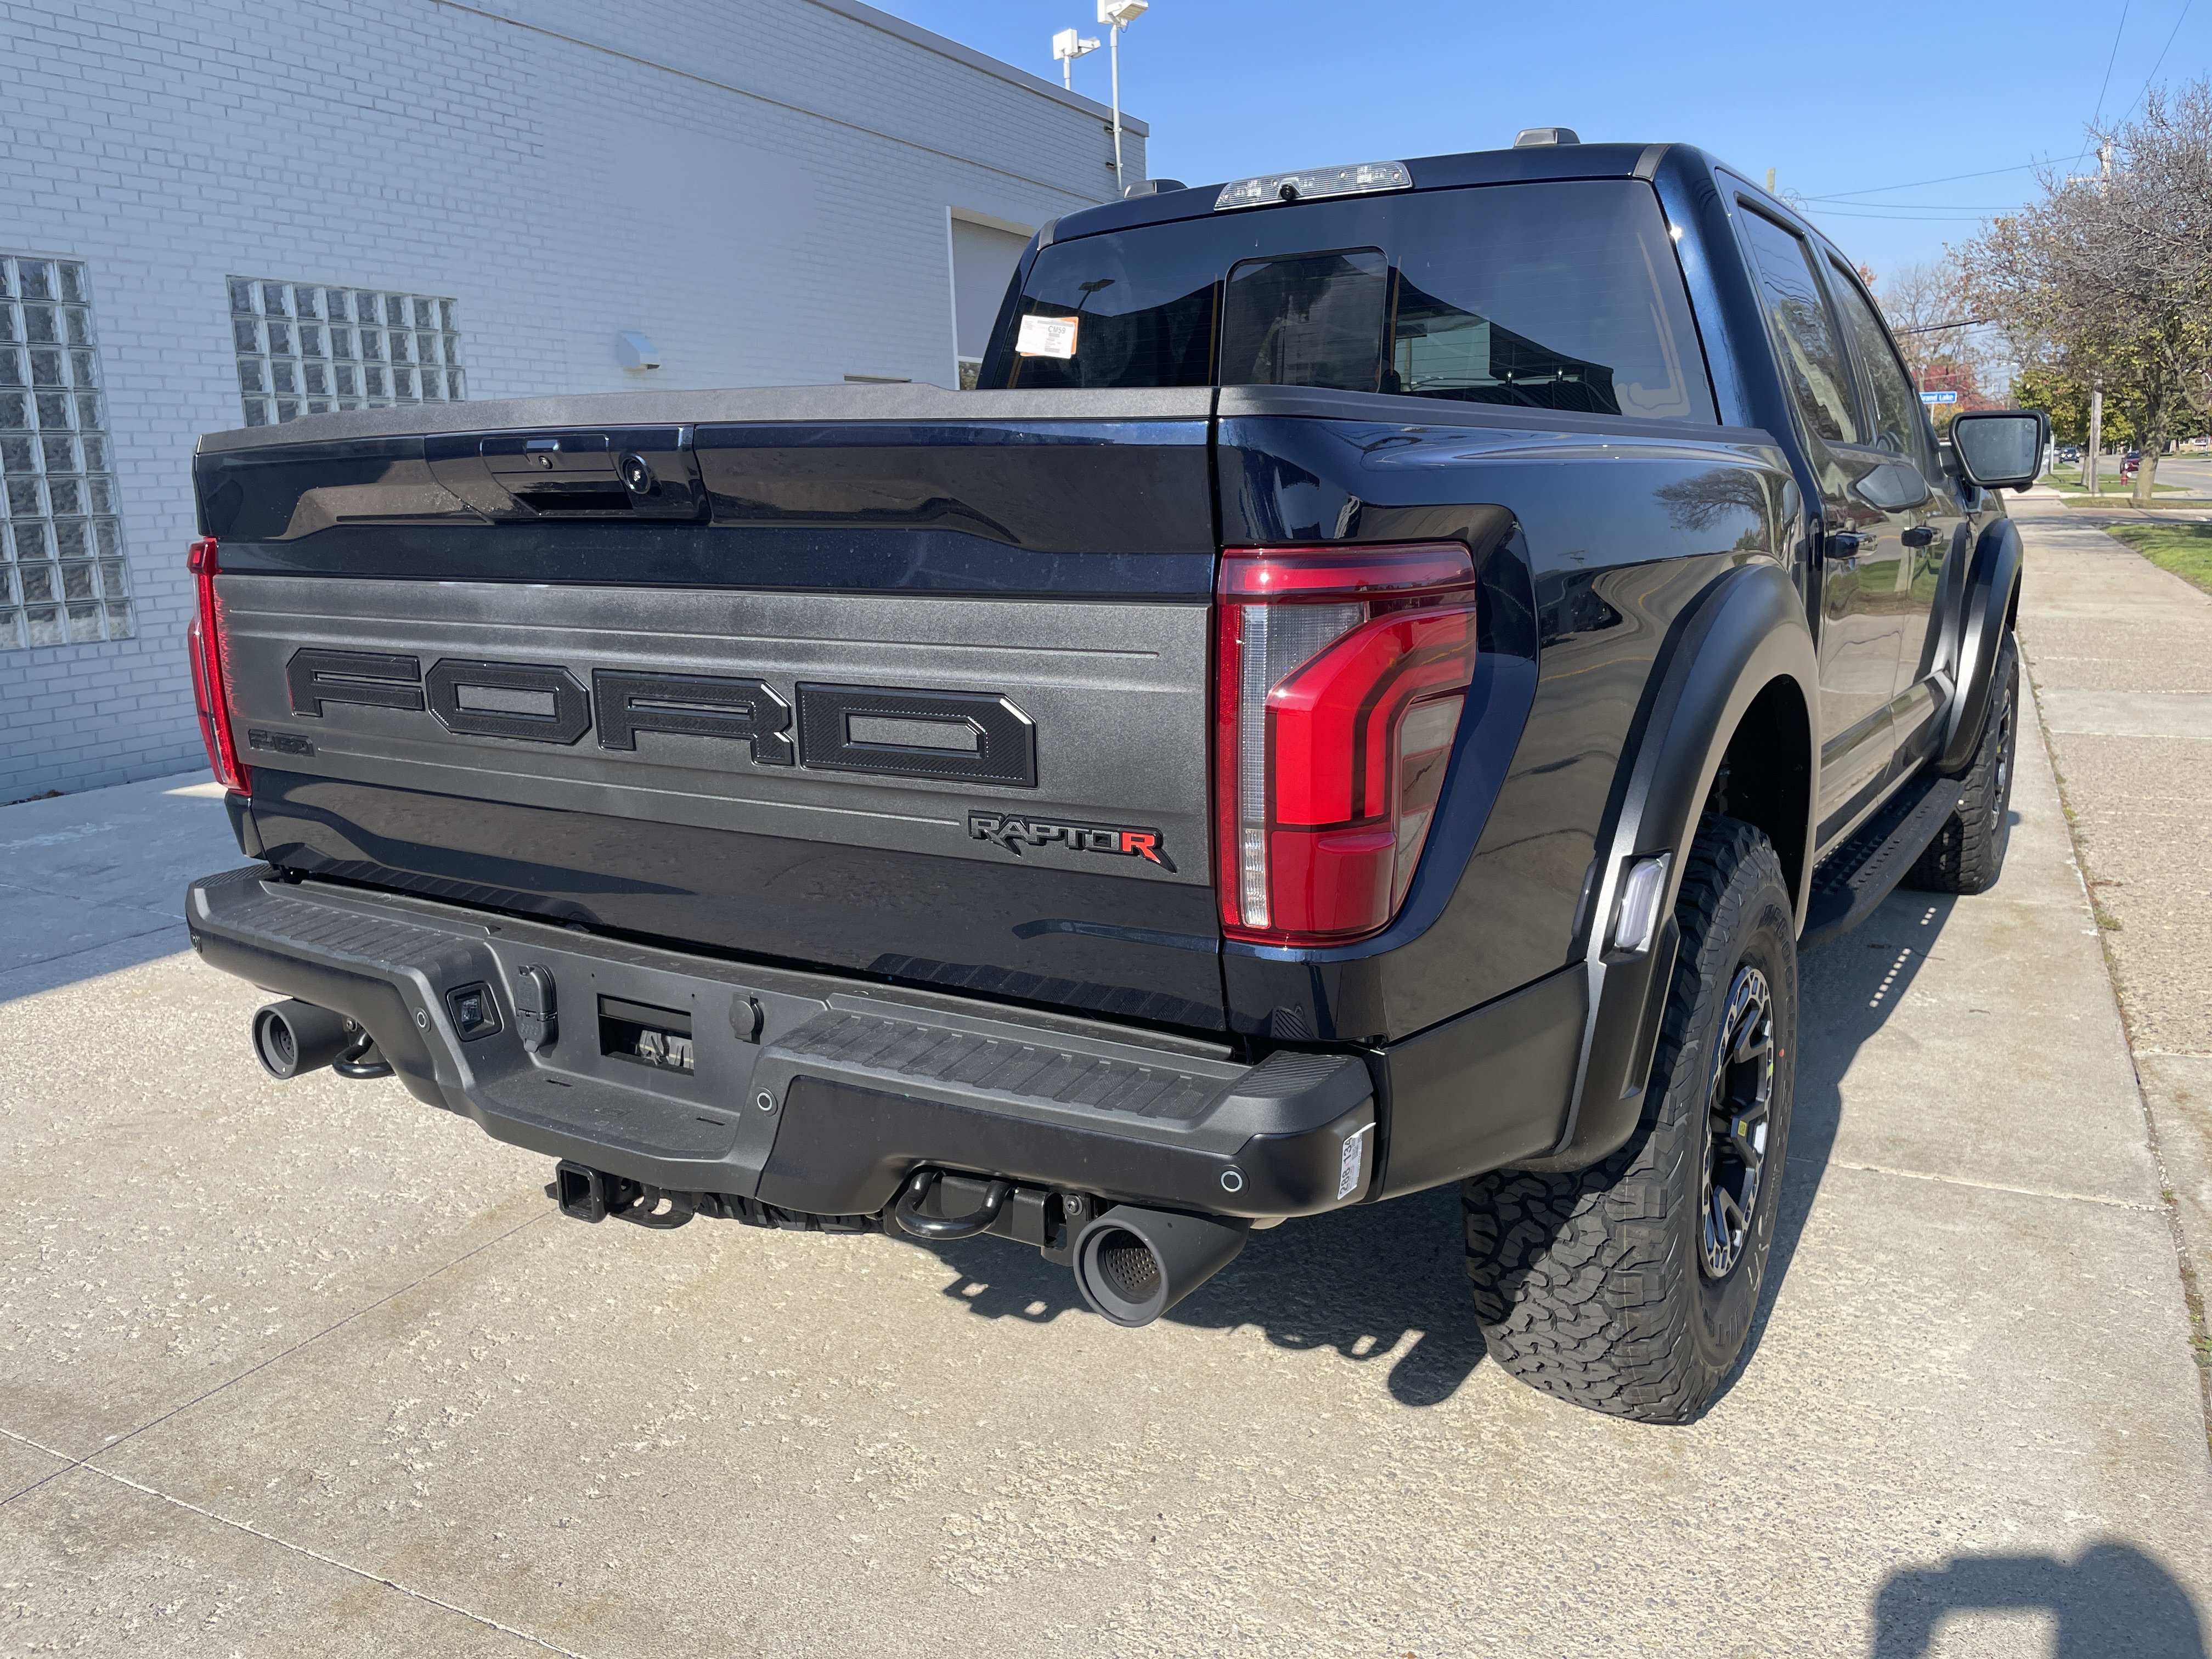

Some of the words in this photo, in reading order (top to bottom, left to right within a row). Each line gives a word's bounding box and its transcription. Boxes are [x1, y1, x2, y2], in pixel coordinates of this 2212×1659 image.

[285, 646, 1038, 788] FORD
[968, 810, 1178, 873] RAPTOR
[1340, 1167, 1350, 1194] 288
